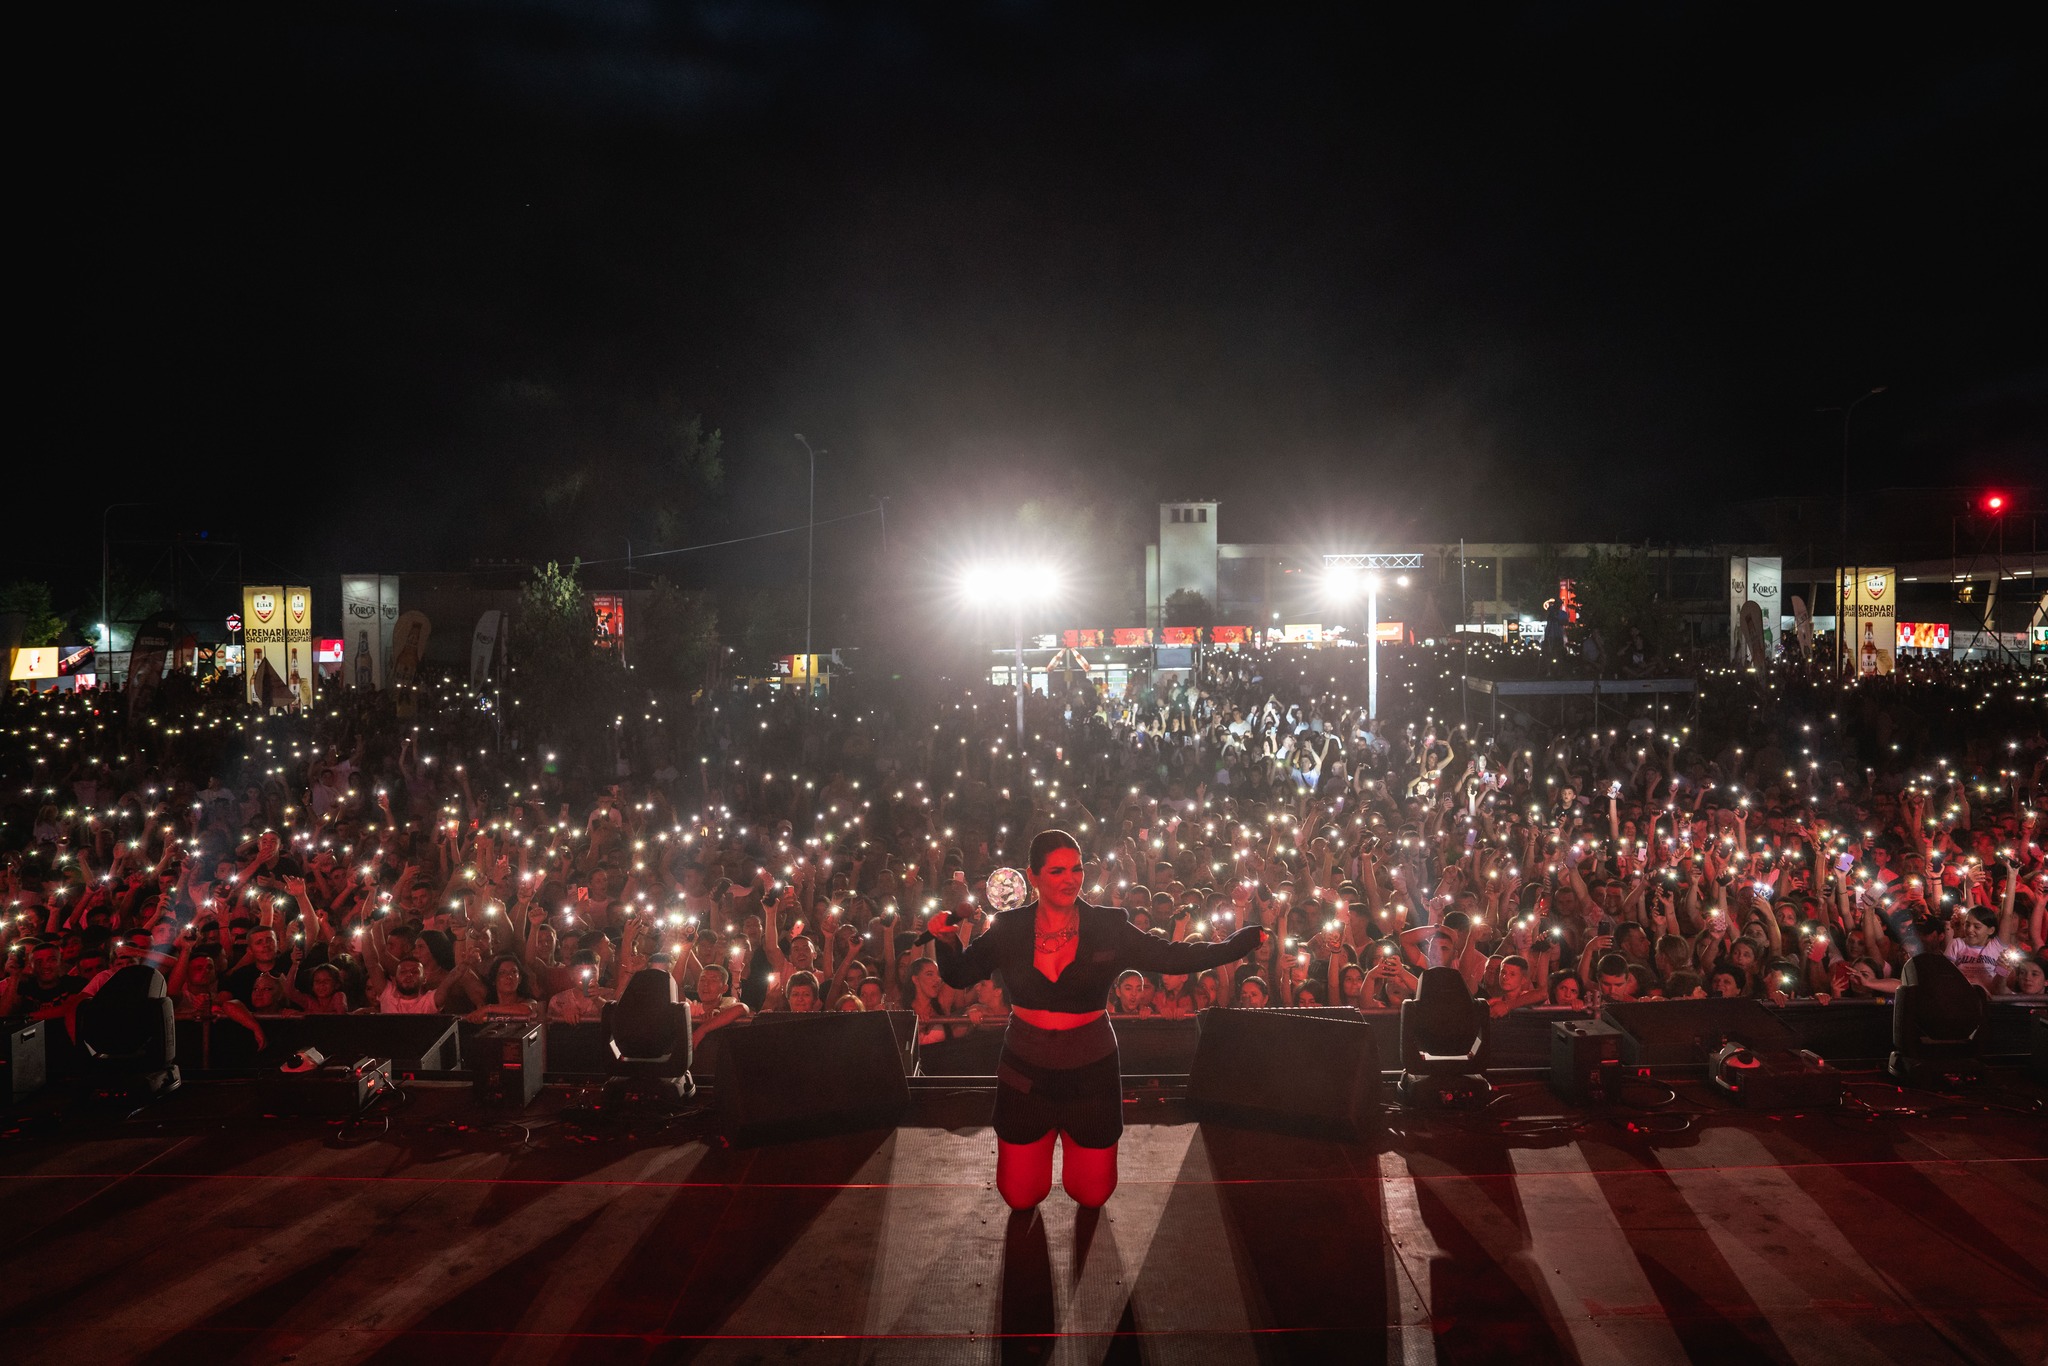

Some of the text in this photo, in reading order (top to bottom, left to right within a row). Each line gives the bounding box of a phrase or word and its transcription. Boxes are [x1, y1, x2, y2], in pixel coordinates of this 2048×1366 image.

[1752, 583, 1778, 597] KORÇA
[349, 603, 376, 619] KORÇA
[1858, 604, 1894, 612] KRENARI
[245, 628, 285, 637] KRENARI
[287, 628, 311, 637] KRENARI
